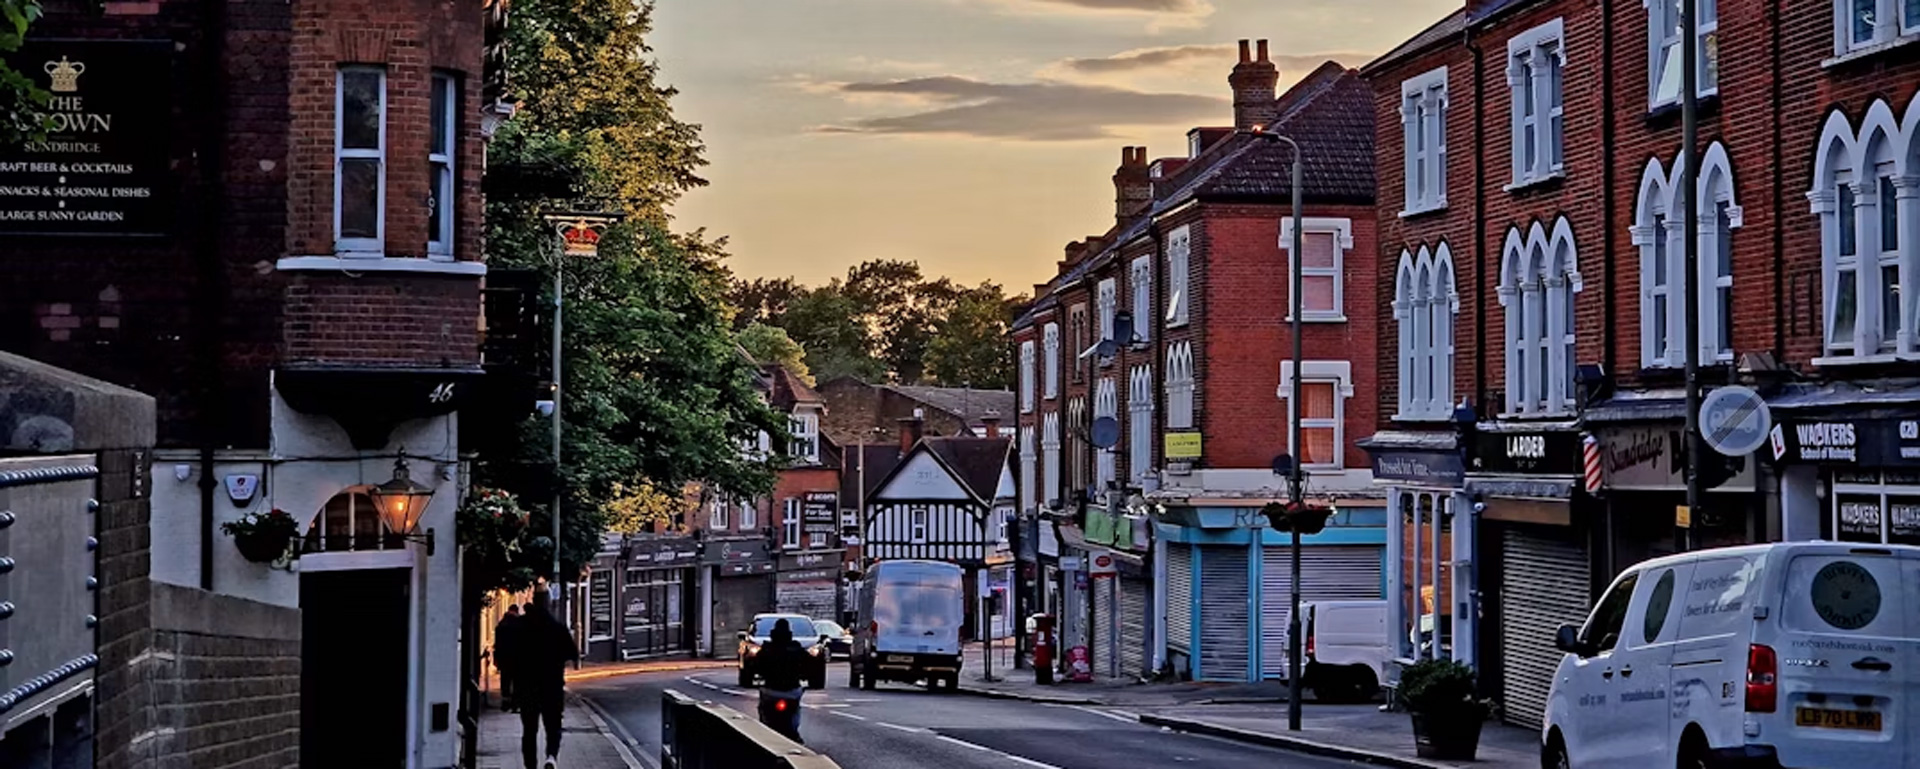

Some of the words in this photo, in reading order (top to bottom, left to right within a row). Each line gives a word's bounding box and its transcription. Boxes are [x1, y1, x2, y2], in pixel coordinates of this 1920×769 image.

[48, 96, 83, 111] THE
[24, 142, 101, 153] SUNDRIDGE
[30, 162, 57, 172] BEER
[59, 163, 69, 172] &
[71, 163, 133, 174] COCKTAILS
[41, 187, 52, 196] &
[53, 187, 109, 197] SEASONAL
[112, 187, 151, 197] DISHES
[0, 210, 35, 220] LARGE
[37, 210, 75, 220] SUNNY
[76, 211, 124, 221] GARDEN
[429, 382, 455, 403] 46
[1506, 436, 1546, 459] LARDER
[1610, 429, 1664, 474] Sundridge
[1800, 447, 1820, 459] School
[1821, 447, 1827, 459] of
